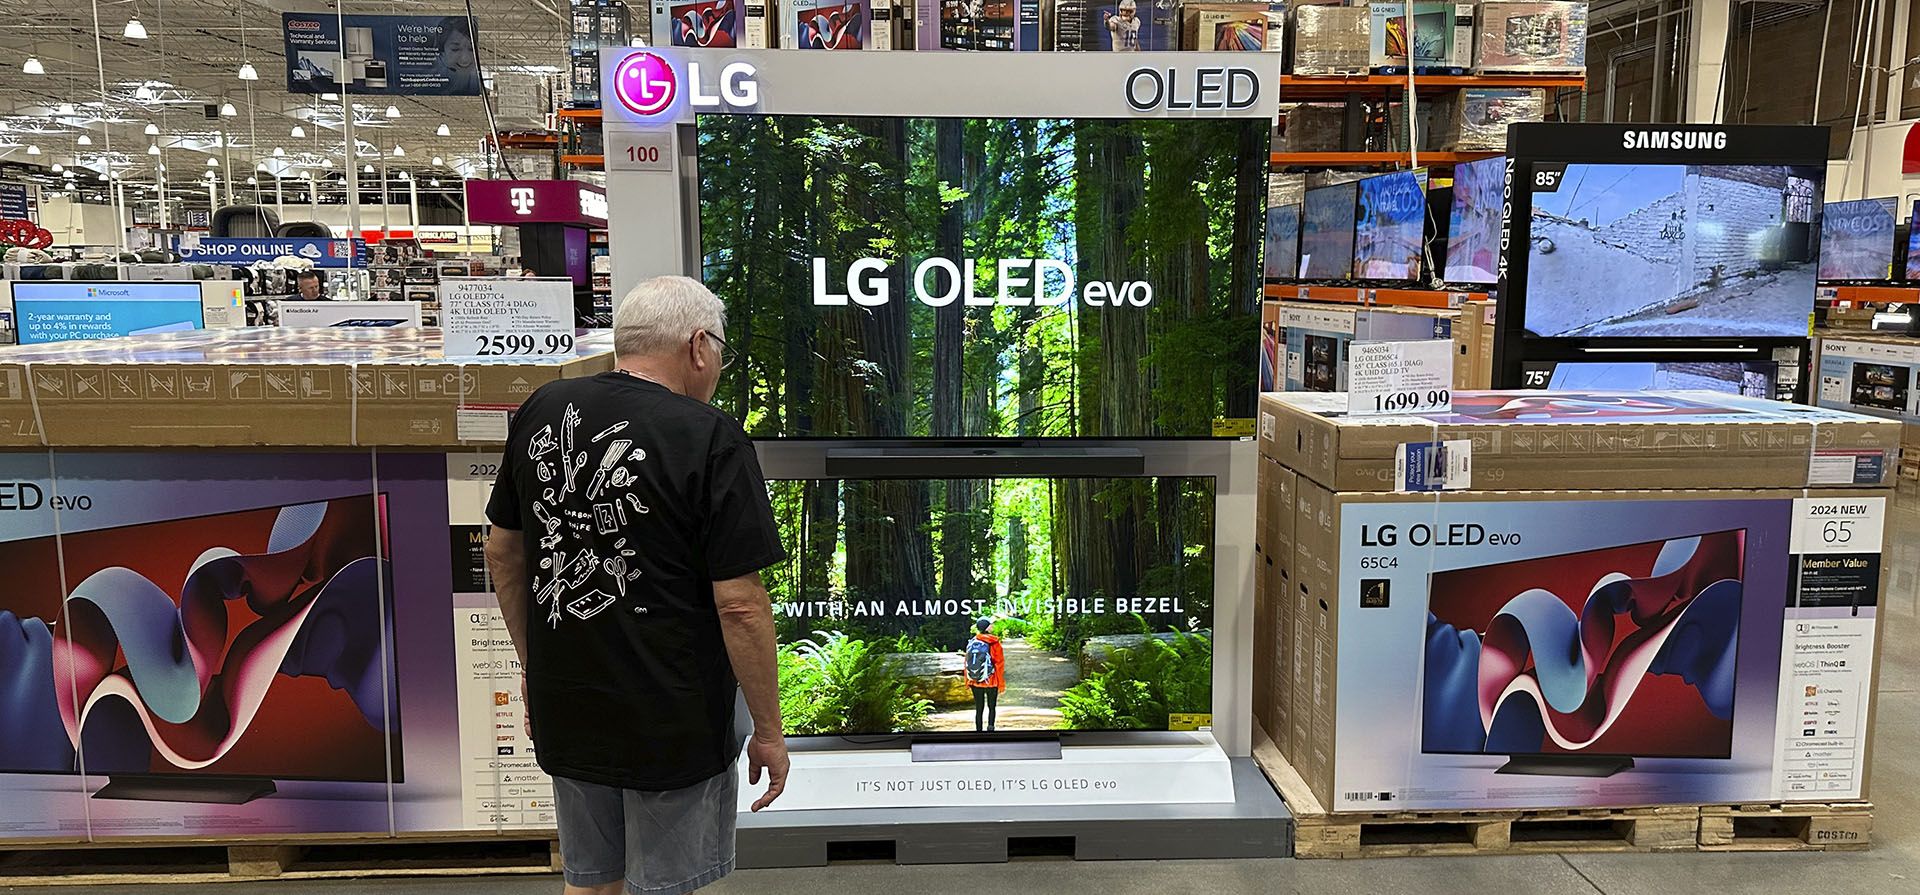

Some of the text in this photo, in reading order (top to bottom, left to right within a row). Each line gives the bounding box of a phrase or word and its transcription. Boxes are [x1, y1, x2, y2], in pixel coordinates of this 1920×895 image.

[288, 21, 320, 29] COSTCO
[398, 24, 443, 34] We're here
[398, 34, 428, 43] to help
[687, 62, 757, 106] LG
[1125, 67, 1260, 111] OLED
[1623, 130, 1727, 150] SAMSUNG
[626, 146, 659, 162] 100
[1534, 171, 1561, 186] 85"
[510, 187, 535, 215] T
[1498, 158, 1515, 280] Neo QLED 4K
[198, 244, 294, 256] SHOP ONLINE
[813, 257, 1153, 307] LG OLED evo
[98, 289, 129, 297] Microsoft
[28, 313, 54, 322] 2-year
[56, 314, 94, 322] warranty
[29, 323, 40, 332] up
[53, 322, 67, 330] 4%
[68, 322, 77, 330] in
[79, 322, 112, 330] rewards
[30, 331, 47, 339] with
[475, 333, 574, 355] 2599.99
[1525, 370, 1550, 385] 75"
[1374, 390, 1450, 413] 1699.99
[470, 464, 500, 475] 202
[1377, 468, 1394, 481] ED
[0, 482, 92, 511] ED evo
[564, 509, 592, 519] CARBON
[1810, 505, 1867, 515] 2024 NEW
[1361, 523, 1521, 547] LG OLED evo
[1360, 556, 1399, 569] 65C4
[1803, 558, 1868, 569] Member Value
[785, 597, 1185, 618] WITH AN ALMOST INVISIBLE BEZEL
[856, 778, 1118, 793] IT'S NOT JUST OLED, IT'S LG OLED evo
[1817, 830, 1858, 840] COSTCO
